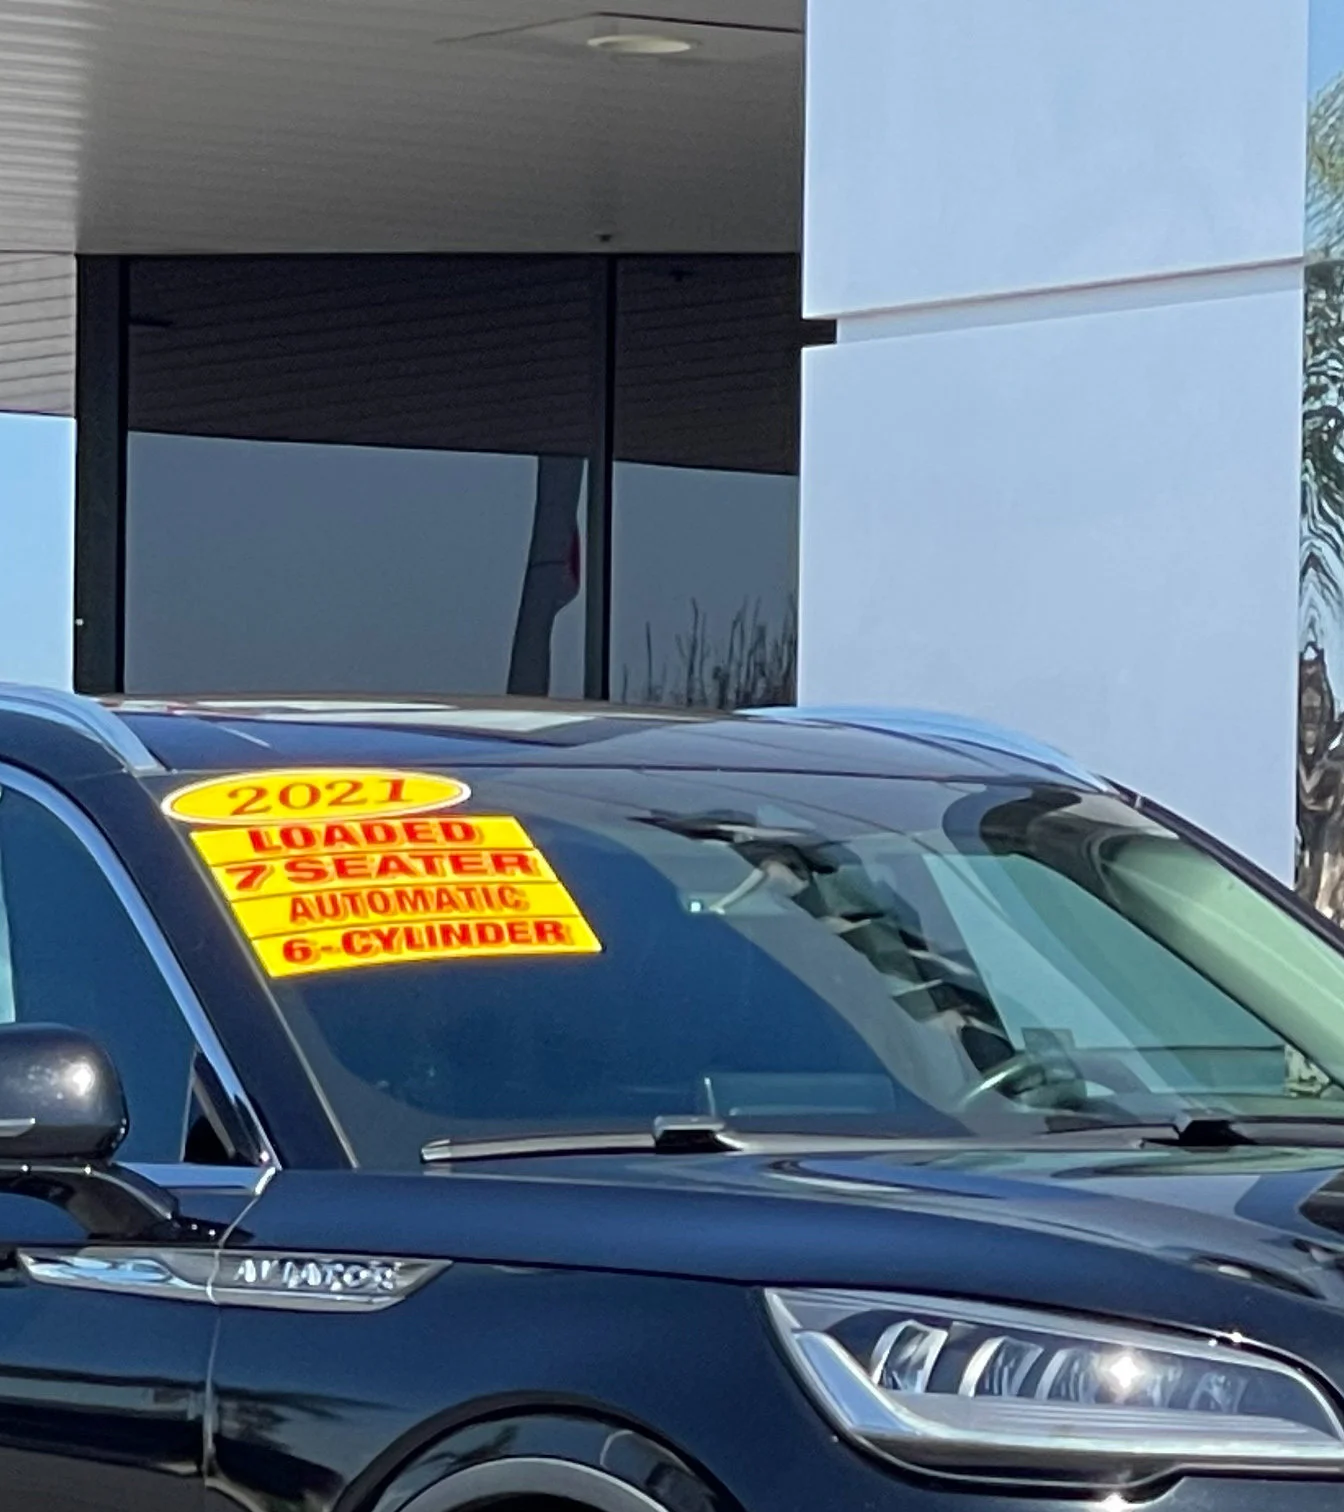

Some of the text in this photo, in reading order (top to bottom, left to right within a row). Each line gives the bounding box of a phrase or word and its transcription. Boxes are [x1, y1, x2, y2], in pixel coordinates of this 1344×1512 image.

[226, 777, 413, 817] 2021
[248, 820, 484, 856] LOADED
[225, 851, 537, 892] 7 SEATER
[288, 884, 530, 924] AUTOMATIC
[282, 919, 571, 965] 6-CYLINDER
